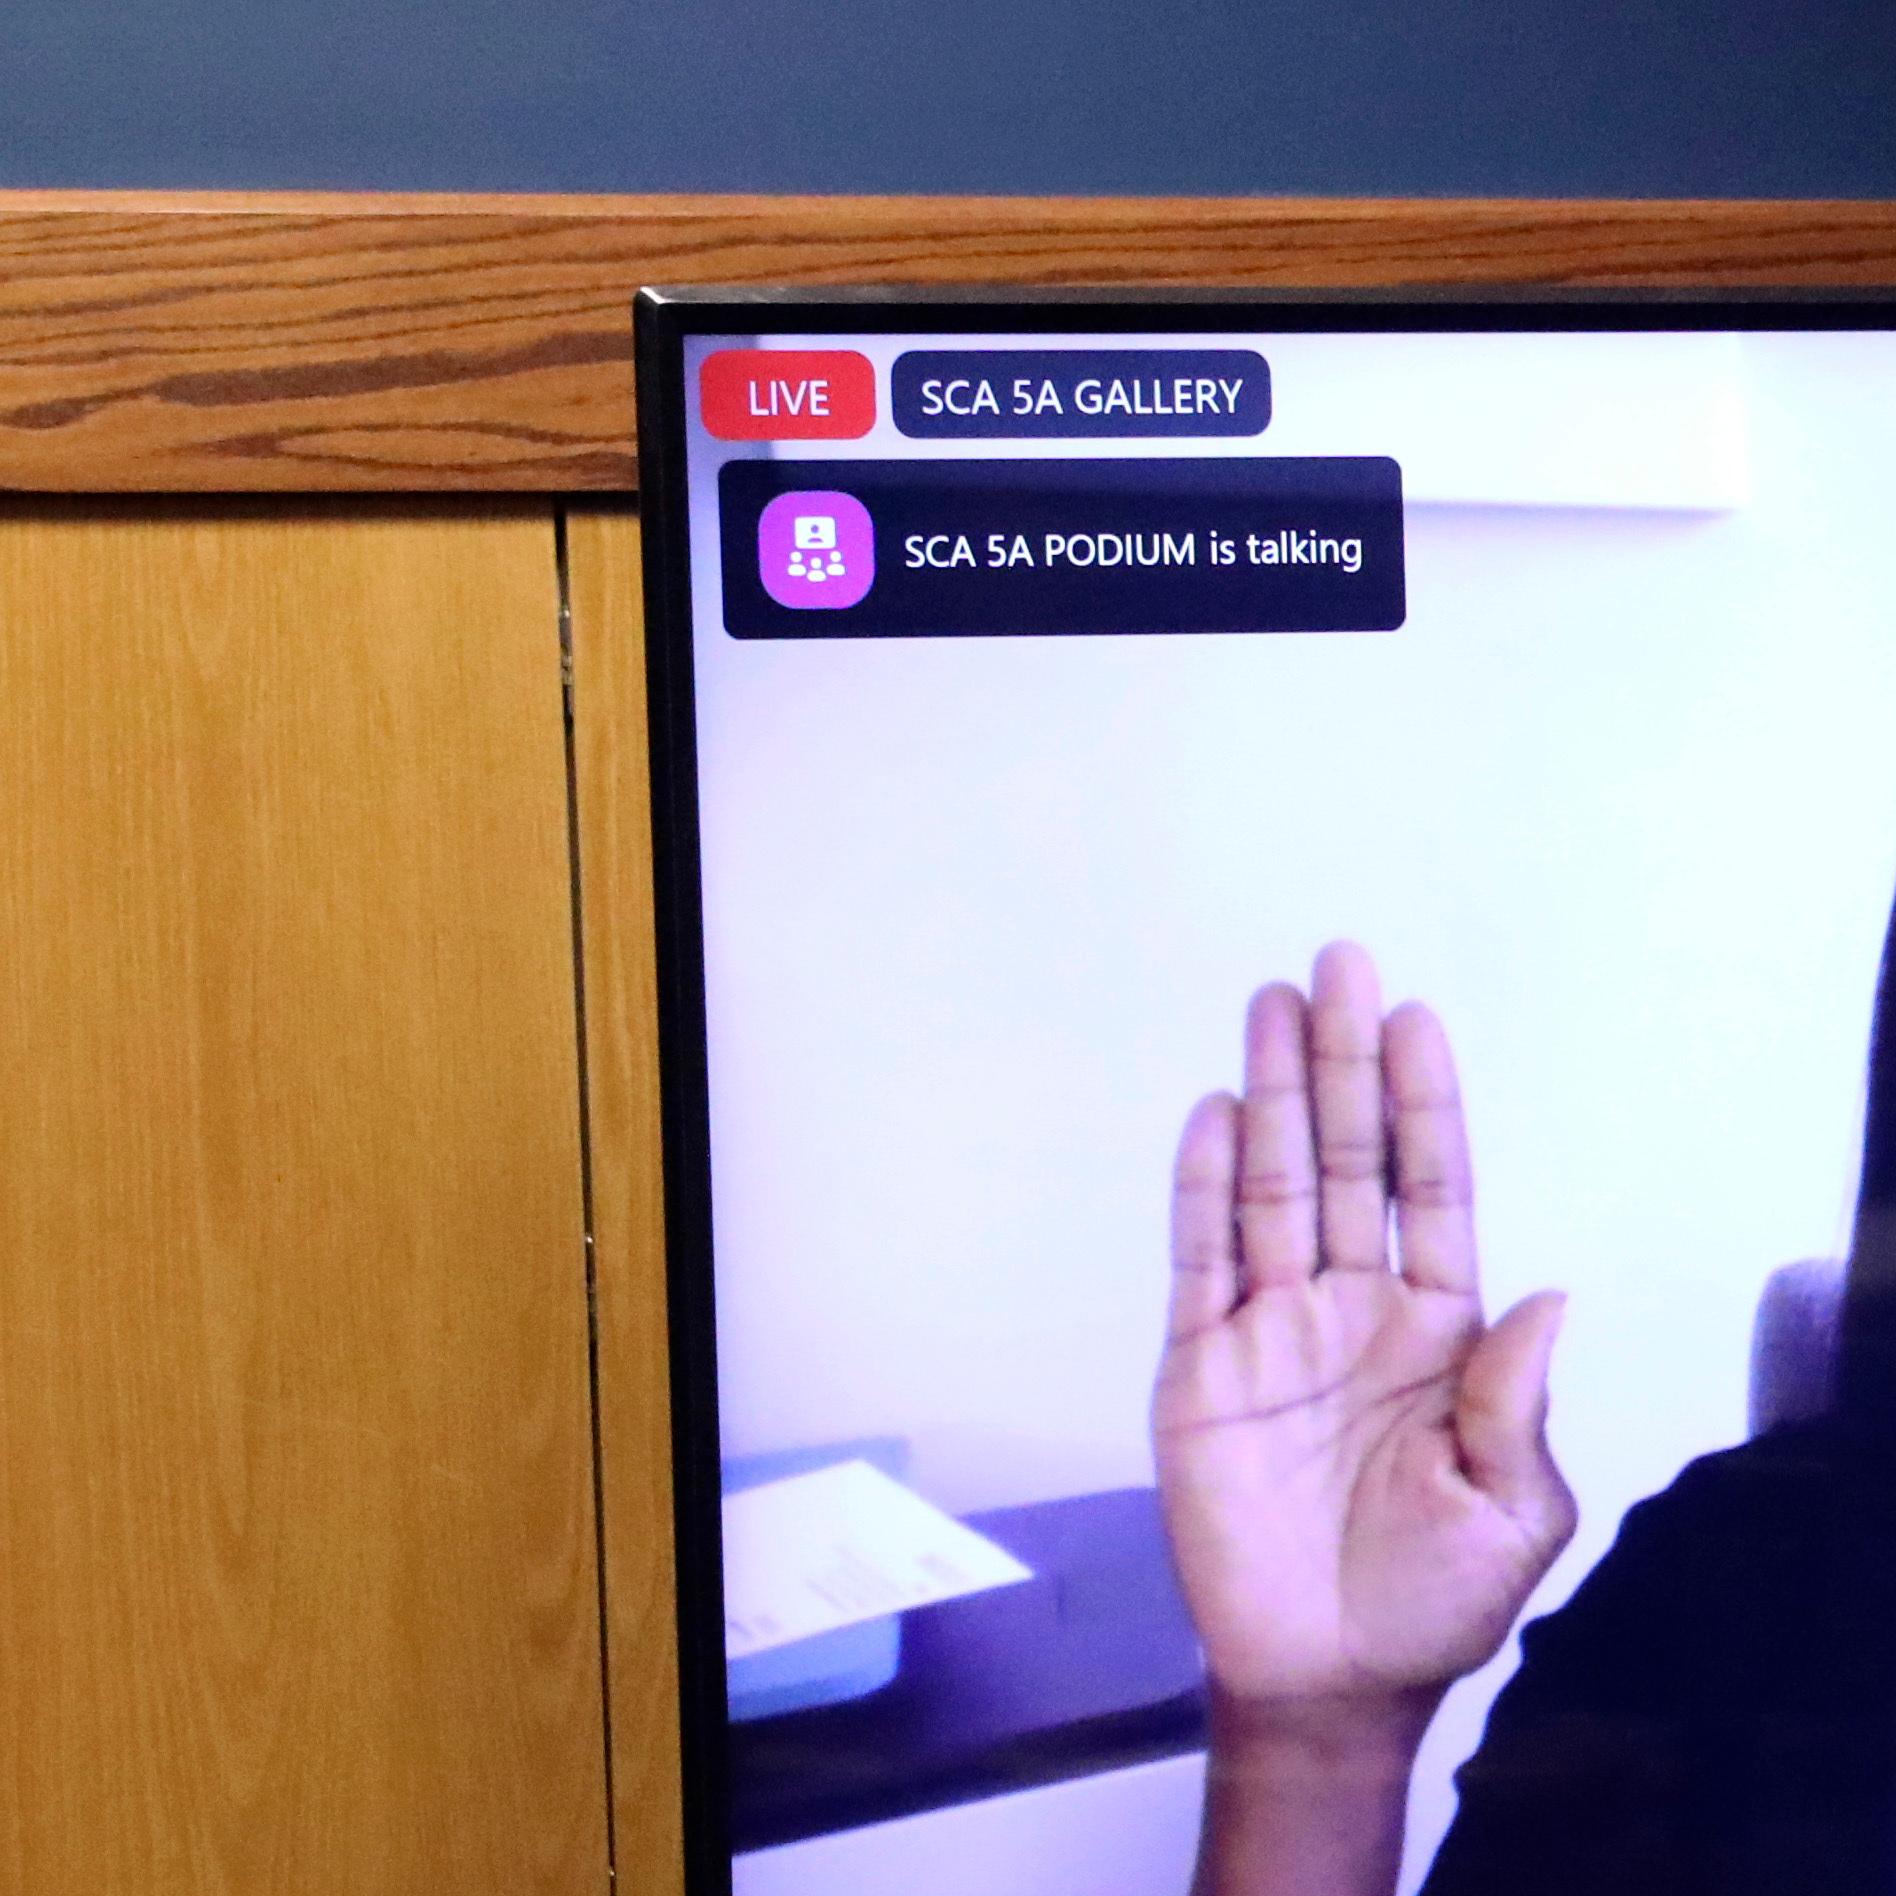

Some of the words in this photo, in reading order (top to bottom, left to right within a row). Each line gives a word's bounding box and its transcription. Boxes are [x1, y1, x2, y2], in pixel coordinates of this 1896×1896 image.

[749, 379, 830, 416] LIVE
[921, 379, 1000, 415] SCA
[1013, 379, 1064, 415] 5A
[1074, 378, 1243, 415] GALLERY
[905, 535, 977, 568] SCA
[987, 534, 1035, 568] 5A
[1045, 533, 1195, 567] PODIUM
[1210, 530, 1236, 565] is
[1245, 529, 1362, 573] talking
